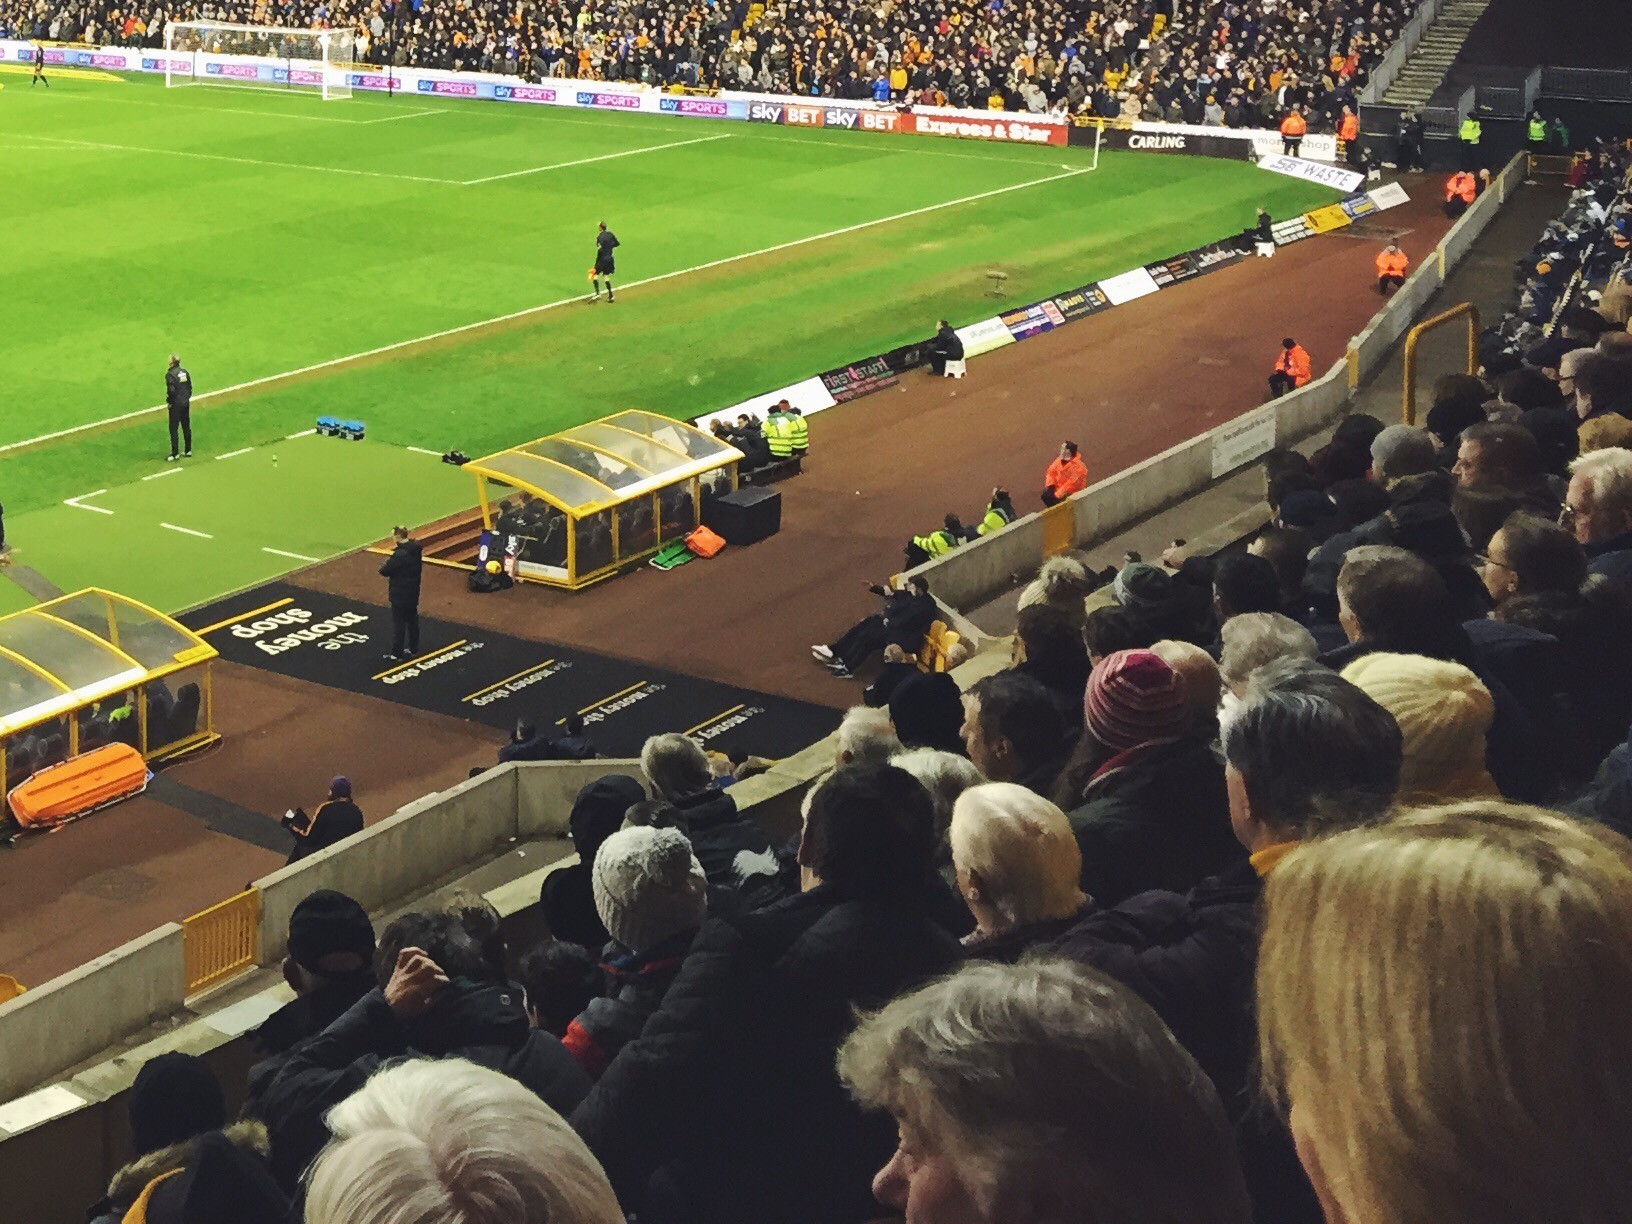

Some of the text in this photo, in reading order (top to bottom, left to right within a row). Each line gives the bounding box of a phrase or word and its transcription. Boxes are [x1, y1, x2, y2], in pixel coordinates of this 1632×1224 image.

[419, 80, 476, 94] sky SPORTS
[496, 86, 555, 101] sky SPORTS
[578, 93, 640, 107] sky SPORTS
[661, 100, 726, 114] sky SPORTS
[752, 103, 820, 124] sky BET
[826, 108, 898, 130] sky BET
[915, 116, 1051, 143] Express & Star
[1128, 134, 1185, 150] CARLING
[1304, 164, 1352, 187] WASTE
[231, 608, 313, 638] shop
[255, 611, 369, 656] money
[318, 632, 369, 651] the
[415, 649, 467, 671] money
[381, 667, 421, 684] shop
[504, 668, 555, 691] money
[471, 688, 511, 706] shop
[598, 691, 650, 715] money
[697, 715, 749, 739] money
